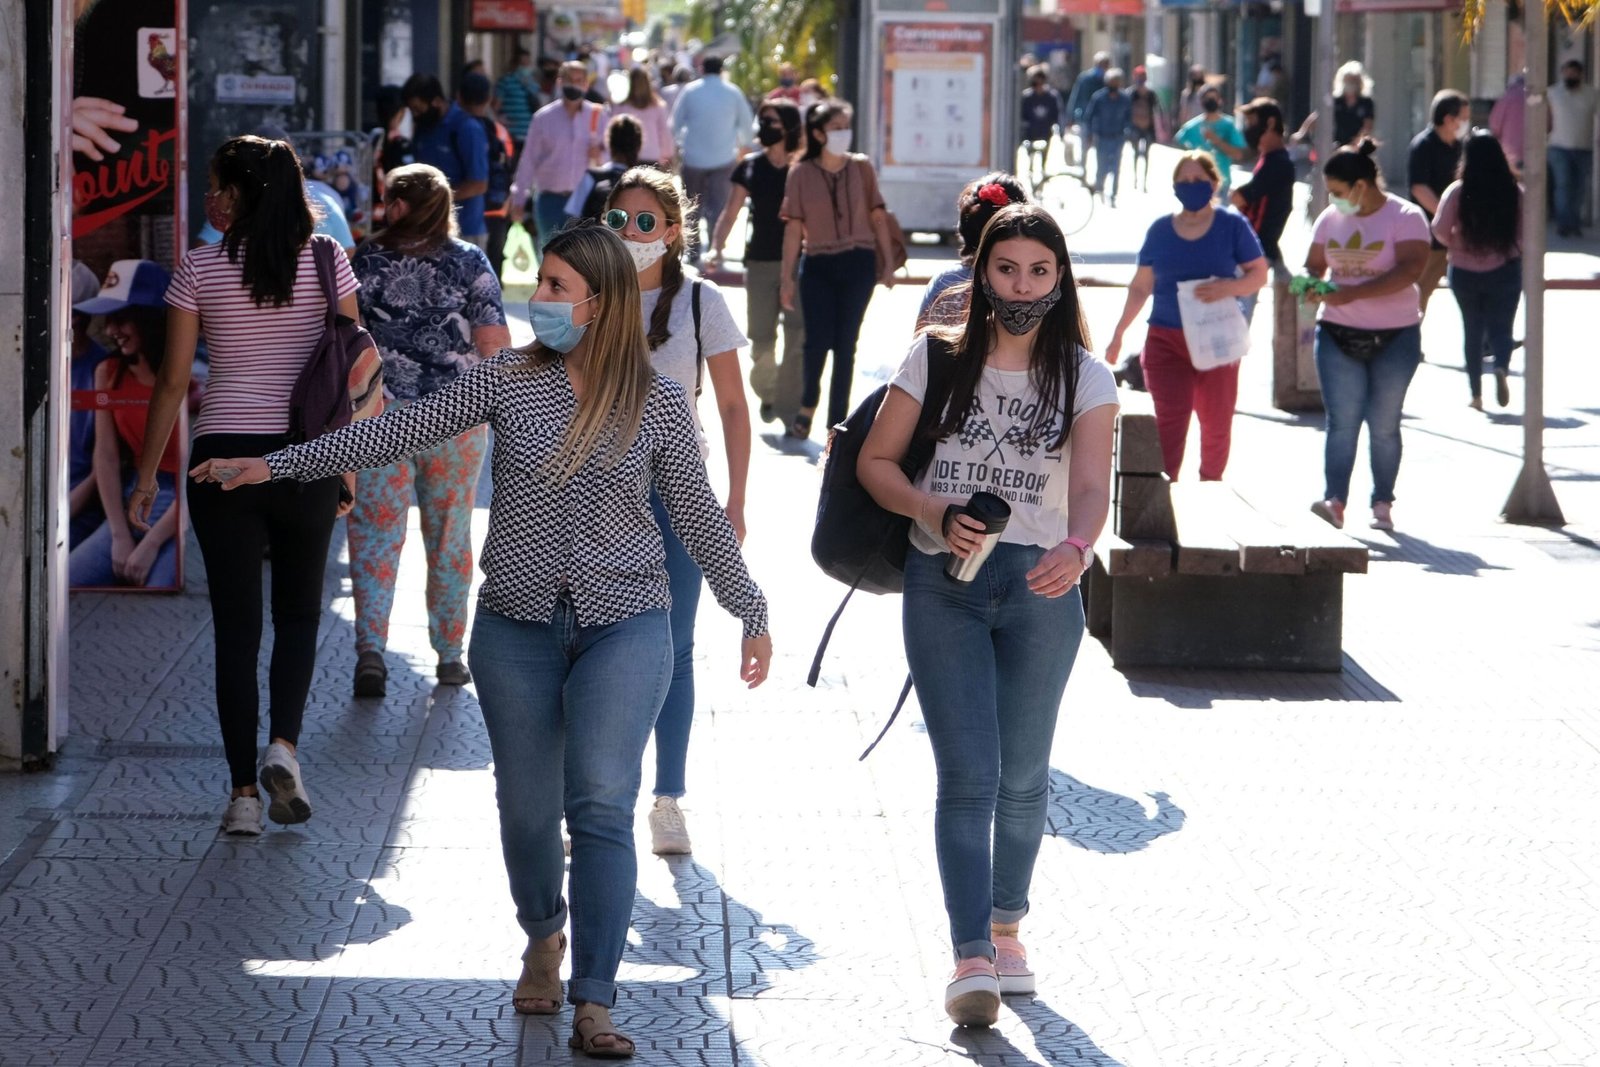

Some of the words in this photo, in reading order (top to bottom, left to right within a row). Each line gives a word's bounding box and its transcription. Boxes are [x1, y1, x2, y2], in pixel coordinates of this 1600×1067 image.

[933, 459, 962, 480] IDE
[966, 462, 988, 482] TO
[950, 483, 958, 494] X
